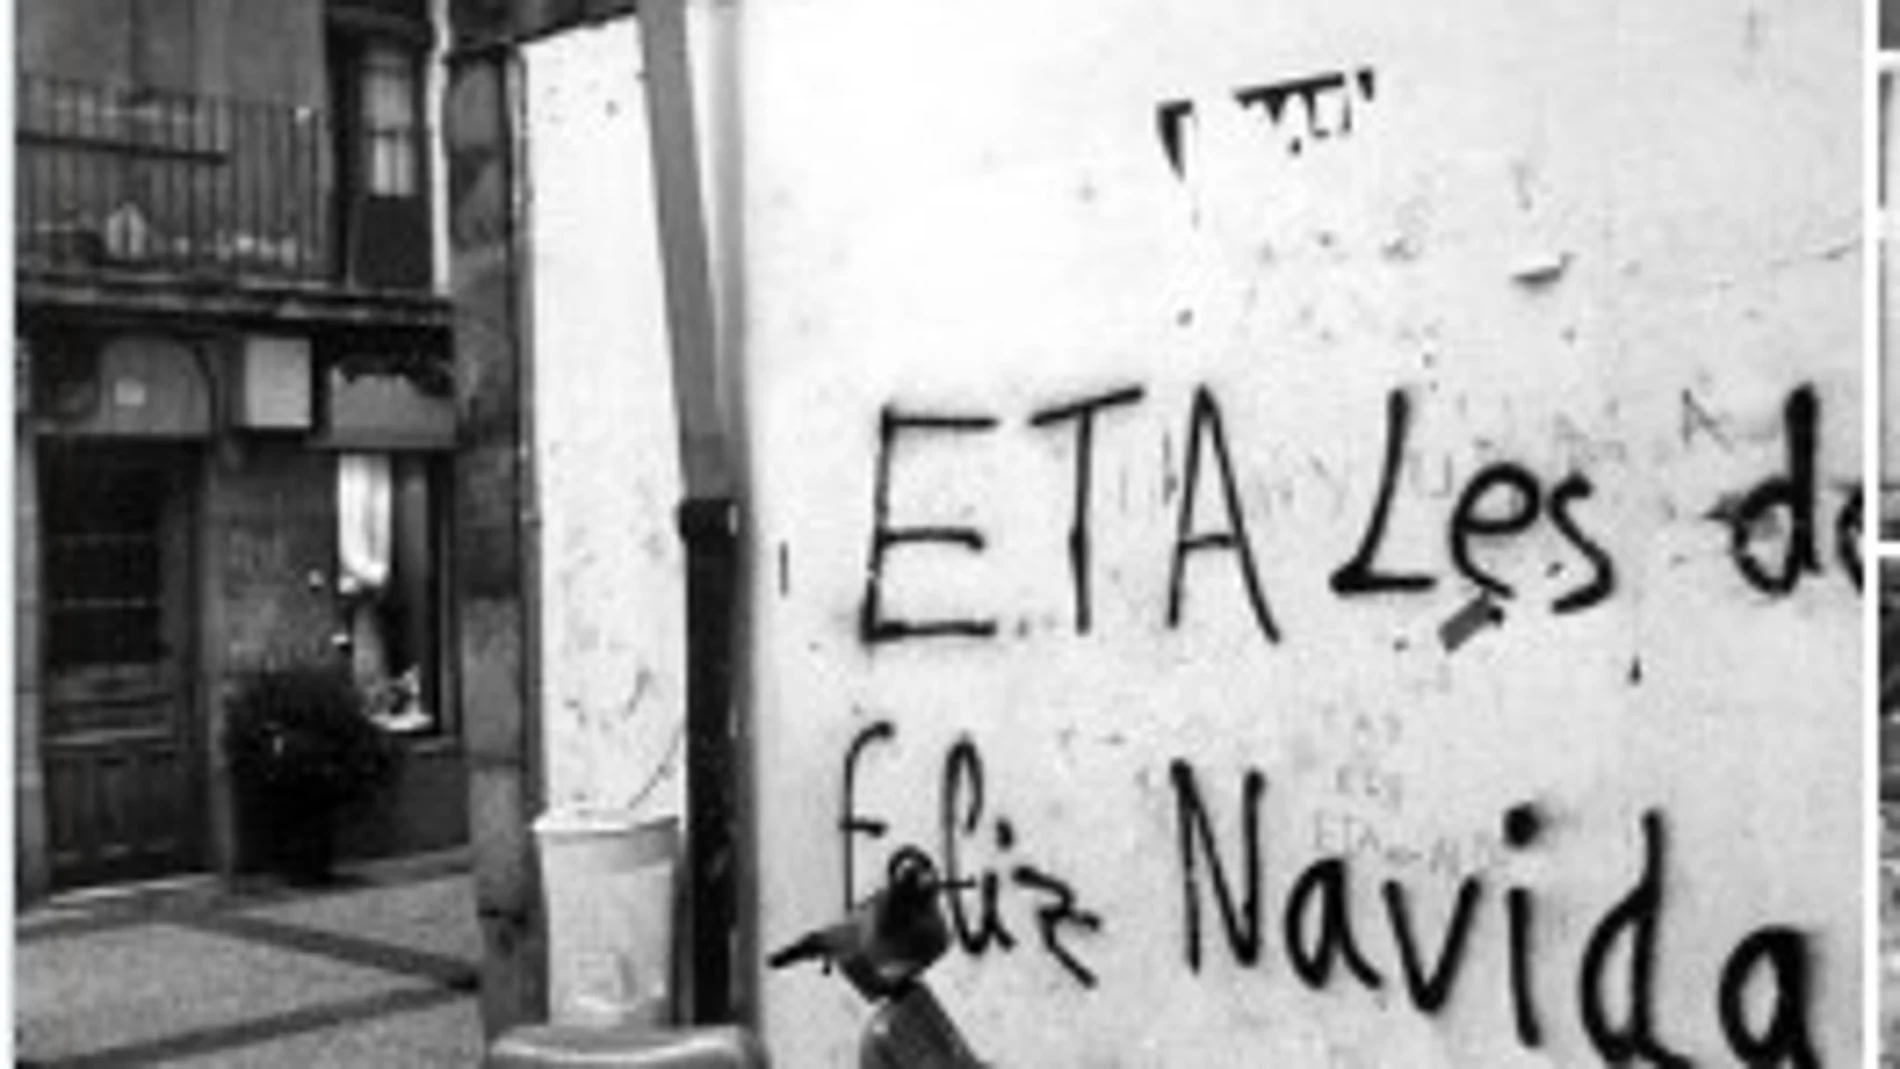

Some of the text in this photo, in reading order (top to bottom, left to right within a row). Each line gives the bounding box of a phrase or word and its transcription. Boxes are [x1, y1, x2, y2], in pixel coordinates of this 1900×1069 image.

[860, 383, 1281, 646] ETA
[1329, 387, 1615, 615] Les
[1170, 758, 1825, 1069] Navida
